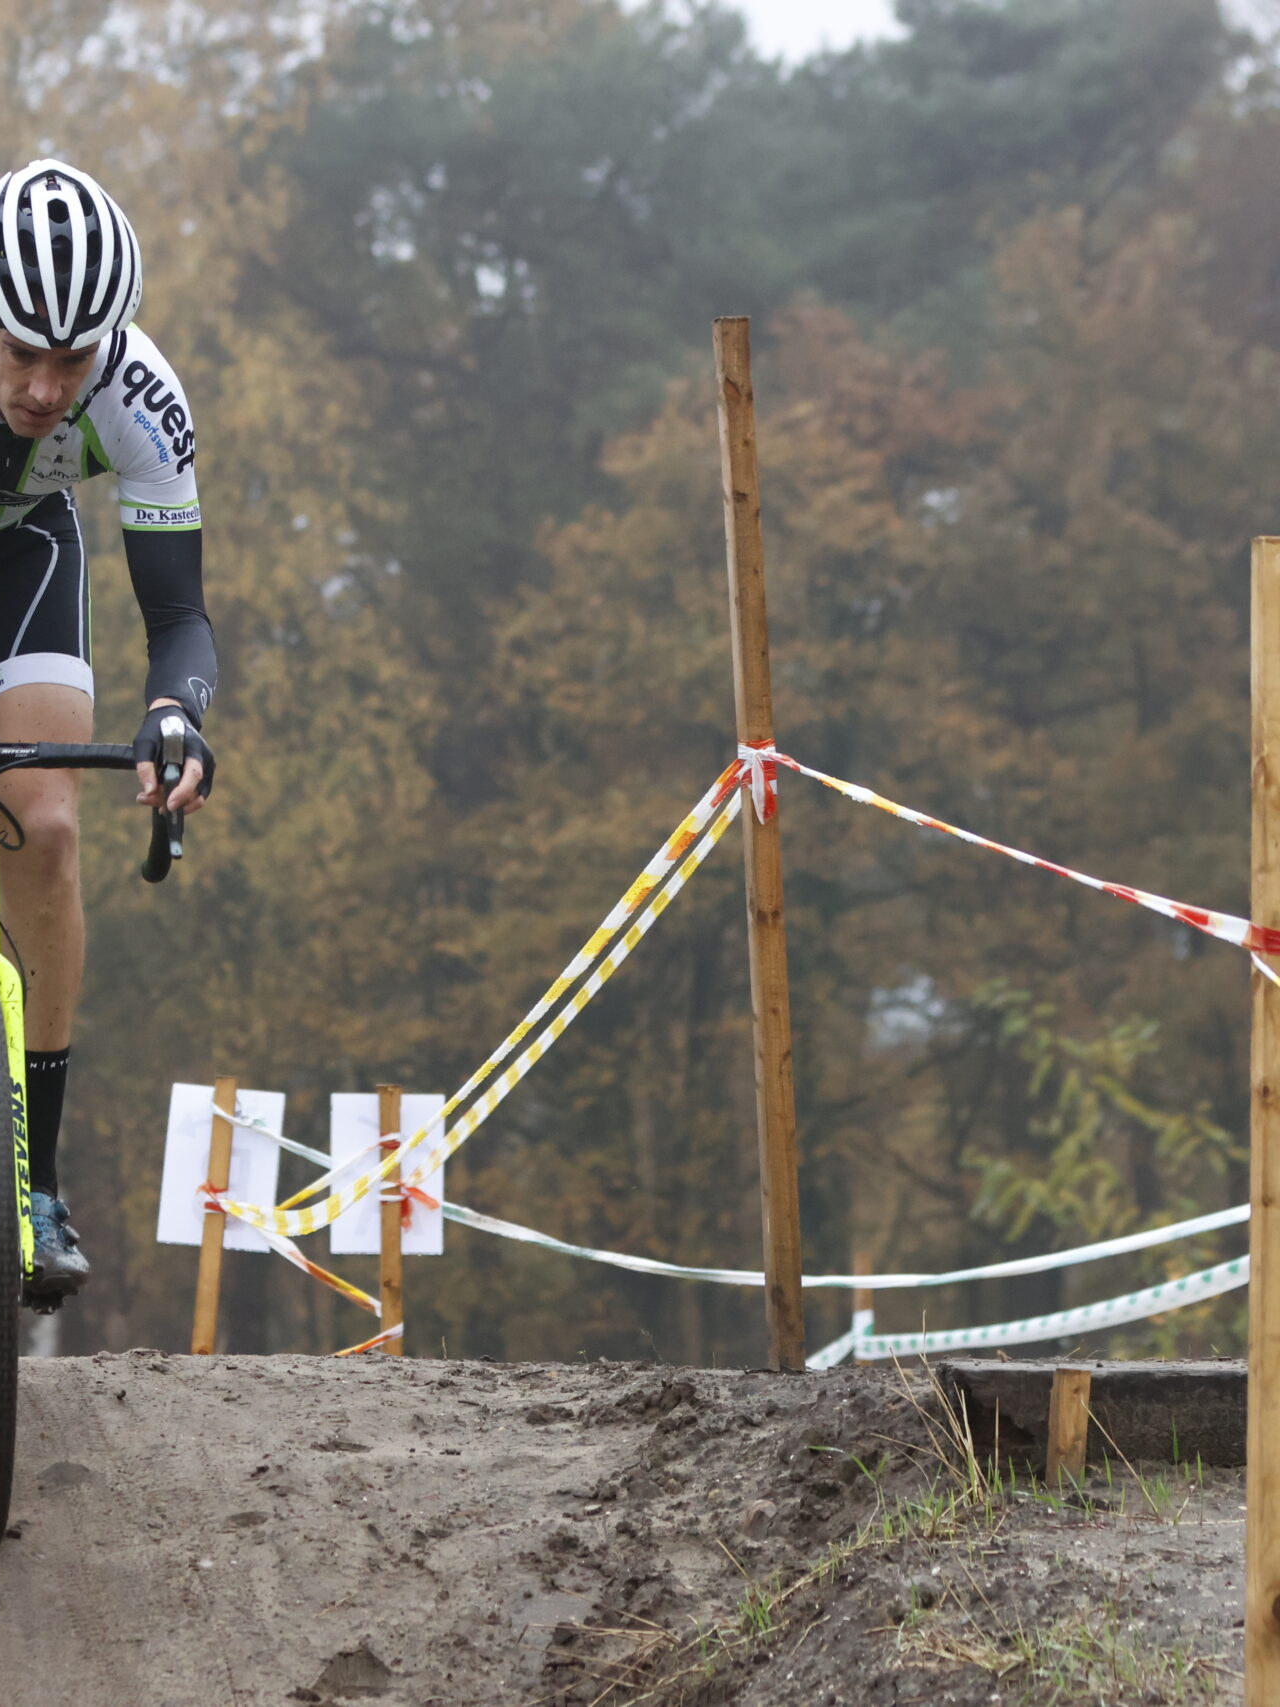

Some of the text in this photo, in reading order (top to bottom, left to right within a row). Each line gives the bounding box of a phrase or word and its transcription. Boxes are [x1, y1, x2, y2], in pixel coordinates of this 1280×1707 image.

[122, 360, 195, 475] quest
[133, 409, 170, 464] sportswear
[136, 509, 155, 520] De
[9, 1077, 32, 1224] STEVENS
